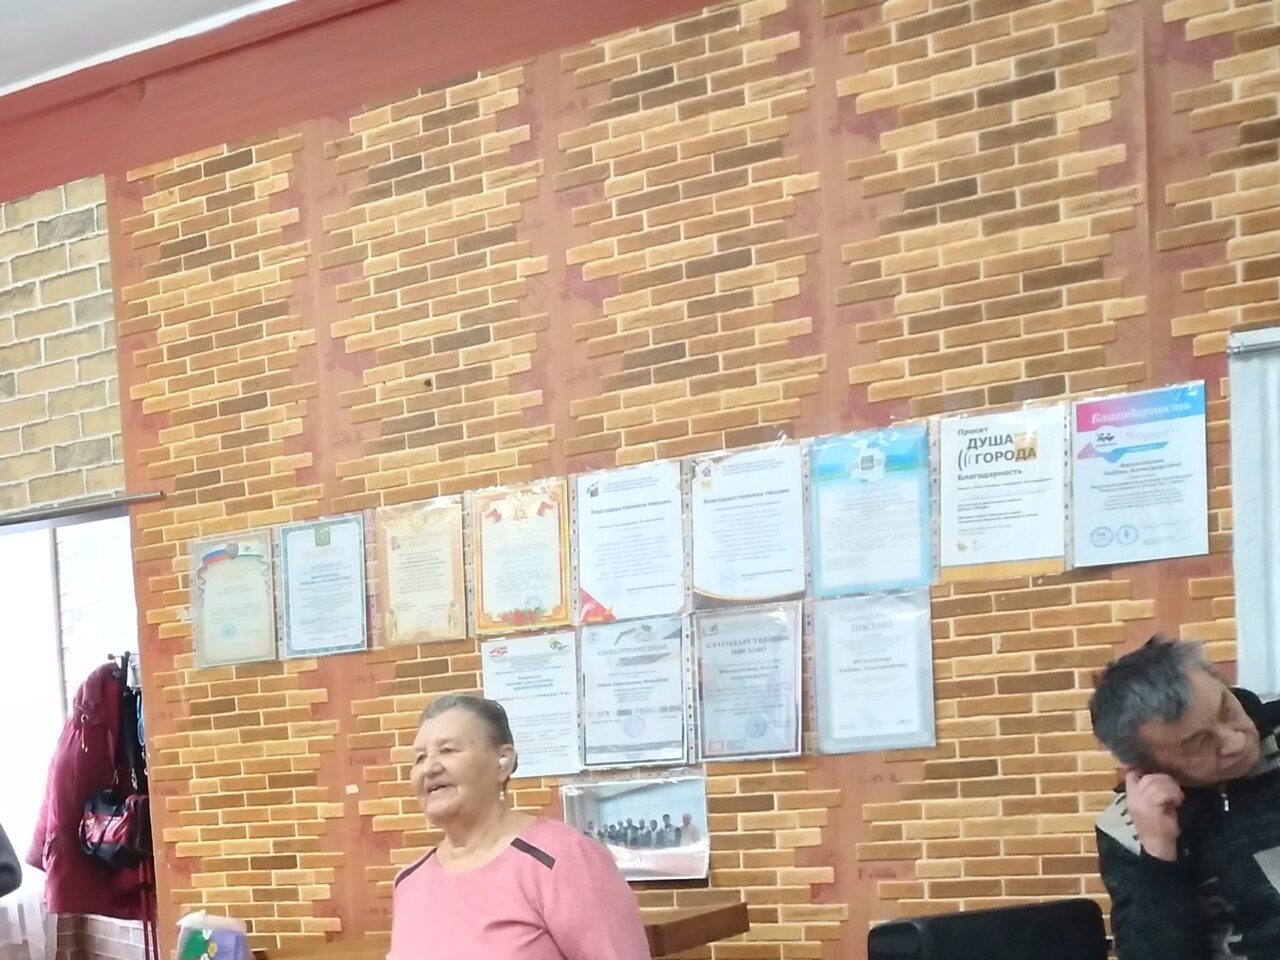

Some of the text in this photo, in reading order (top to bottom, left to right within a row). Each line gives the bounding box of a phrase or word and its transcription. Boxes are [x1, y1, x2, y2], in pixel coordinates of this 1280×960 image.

[1091, 403, 1192, 425] Благодарность
[957, 426, 989, 437] Проект
[966, 433, 1014, 451] ДУША
[974, 447, 1038, 465] ГОРОДА
[957, 468, 1023, 482] Благодарность
